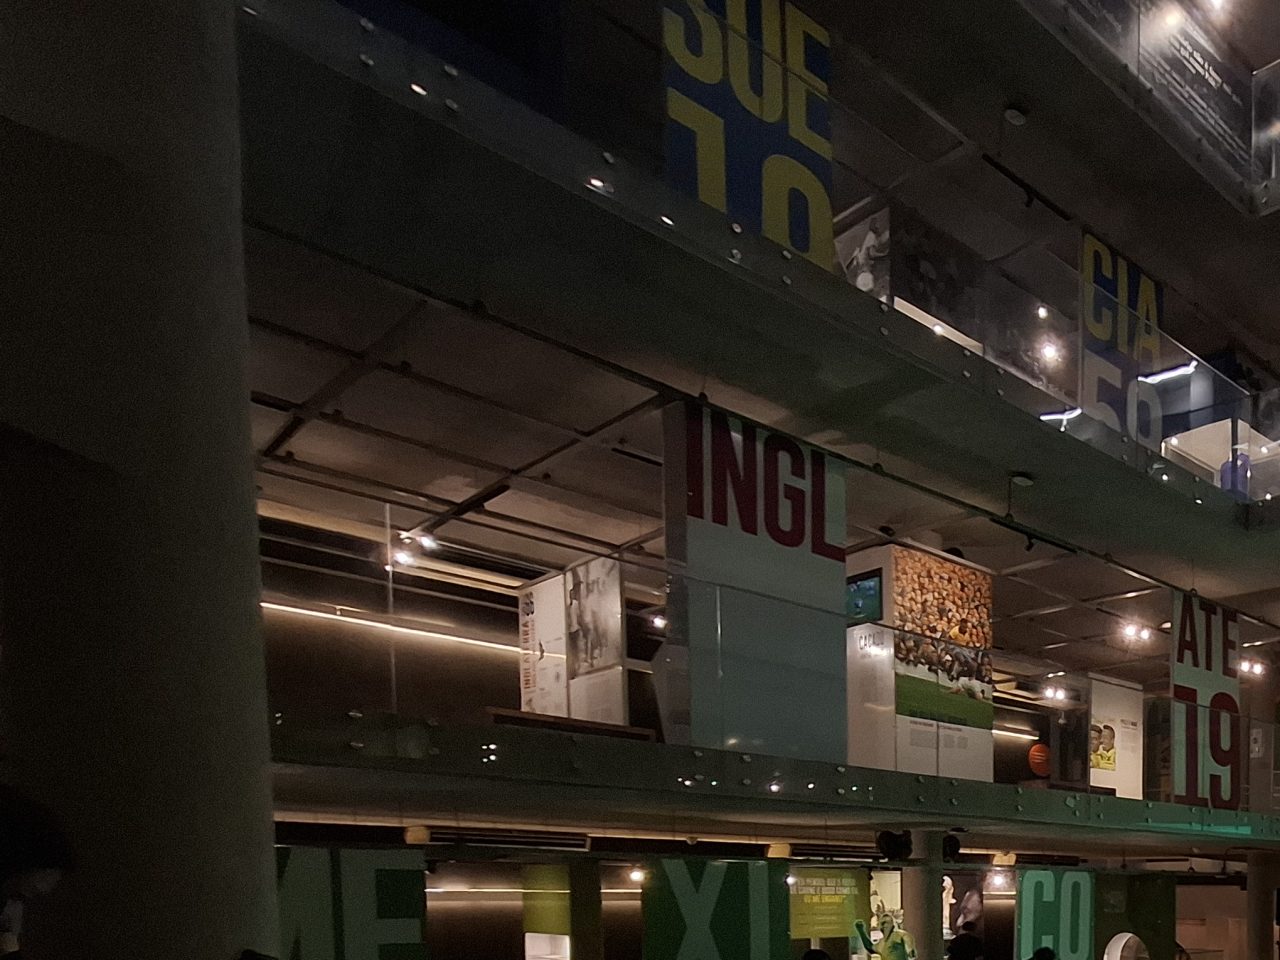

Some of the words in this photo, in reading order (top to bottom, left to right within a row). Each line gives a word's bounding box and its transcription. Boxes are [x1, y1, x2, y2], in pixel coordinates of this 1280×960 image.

[1083, 233, 1160, 368] CIA
[686, 403, 846, 563] INGL
[1177, 594, 1238, 679] ATE
[1174, 684, 1240, 811] 19
